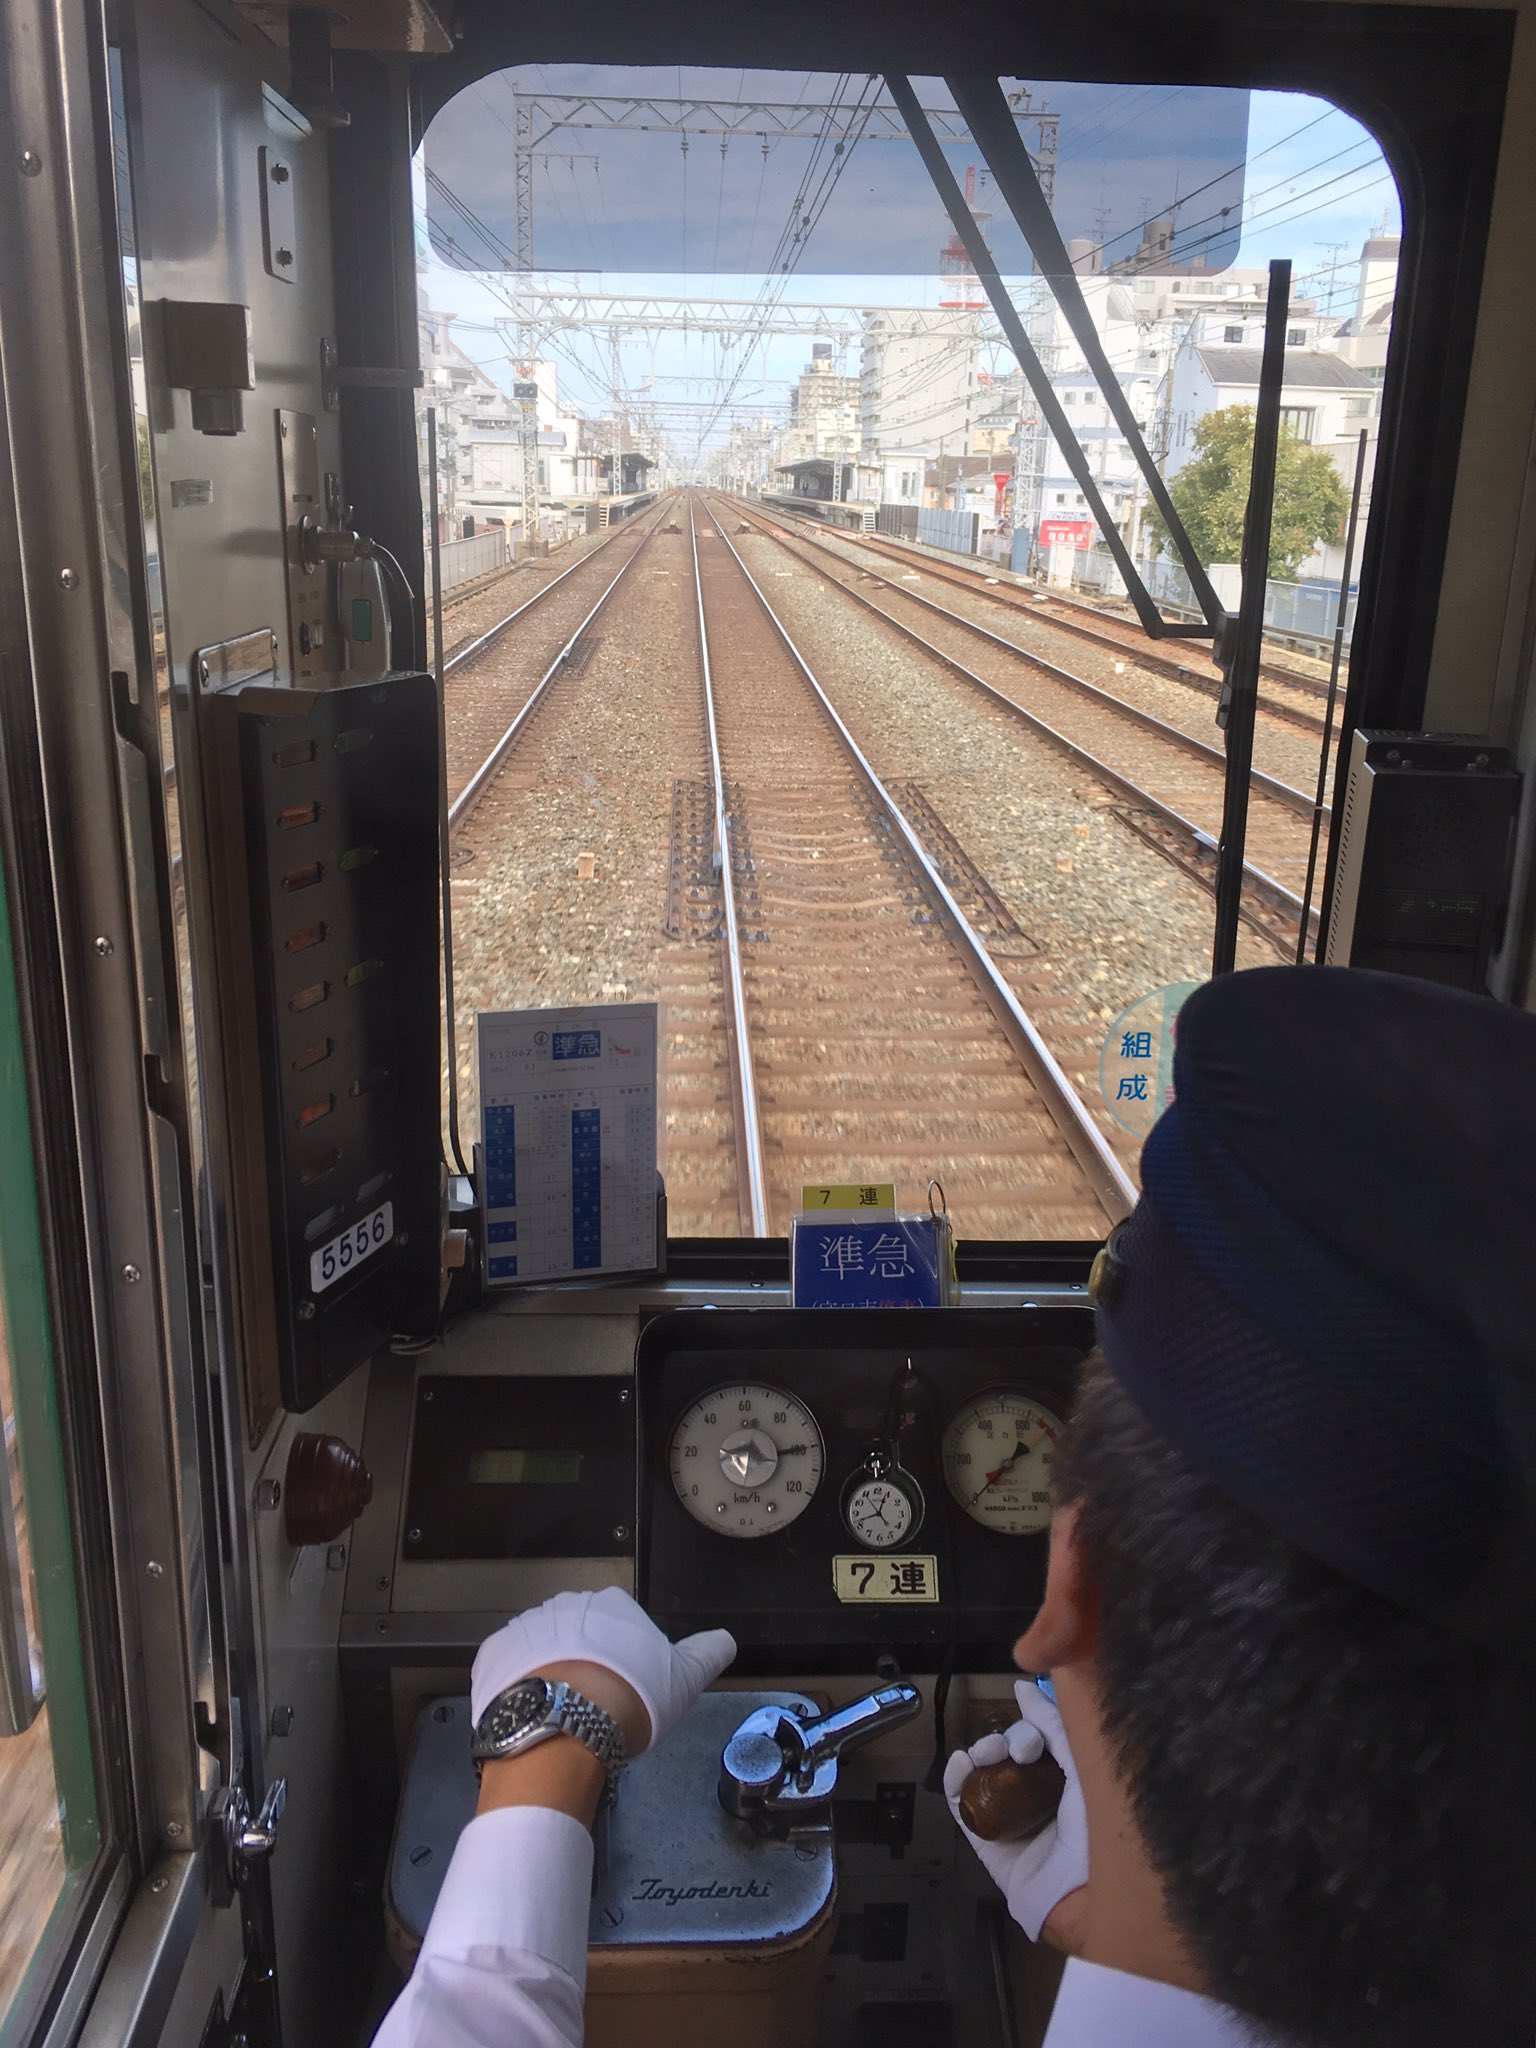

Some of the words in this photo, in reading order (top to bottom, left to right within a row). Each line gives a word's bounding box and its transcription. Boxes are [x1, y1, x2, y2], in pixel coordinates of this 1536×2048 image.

[554, 1033, 600, 1057] 準急
[1116, 1031, 1152, 1100] 組成
[322, 1211, 385, 1280] 5556
[818, 1233, 915, 1281] 準急
[738, 1401, 750, 1412] 60
[704, 1413, 717, 1424] 40
[774, 1412, 786, 1423] 80
[978, 1420, 992, 1430] 400
[1015, 1420, 1030, 1430] 600
[685, 1446, 698, 1457] 20
[957, 1453, 971, 1464] 200
[692, 1484, 699, 1496] 0
[786, 1481, 802, 1492] 120
[873, 1487, 882, 1495] 12
[734, 1491, 760, 1503] km/h
[862, 1490, 870, 1498] 11
[1032, 1492, 1050, 1503] 1000
[855, 1499, 864, 1507] 10
[898, 1510, 904, 1518] 3
[857, 1522, 863, 1530] 8
[894, 1521, 901, 1529] 4
[866, 1529, 873, 1537] 7
[887, 1531, 894, 1539] 5
[632, 1879, 773, 1906] Toyodenki
